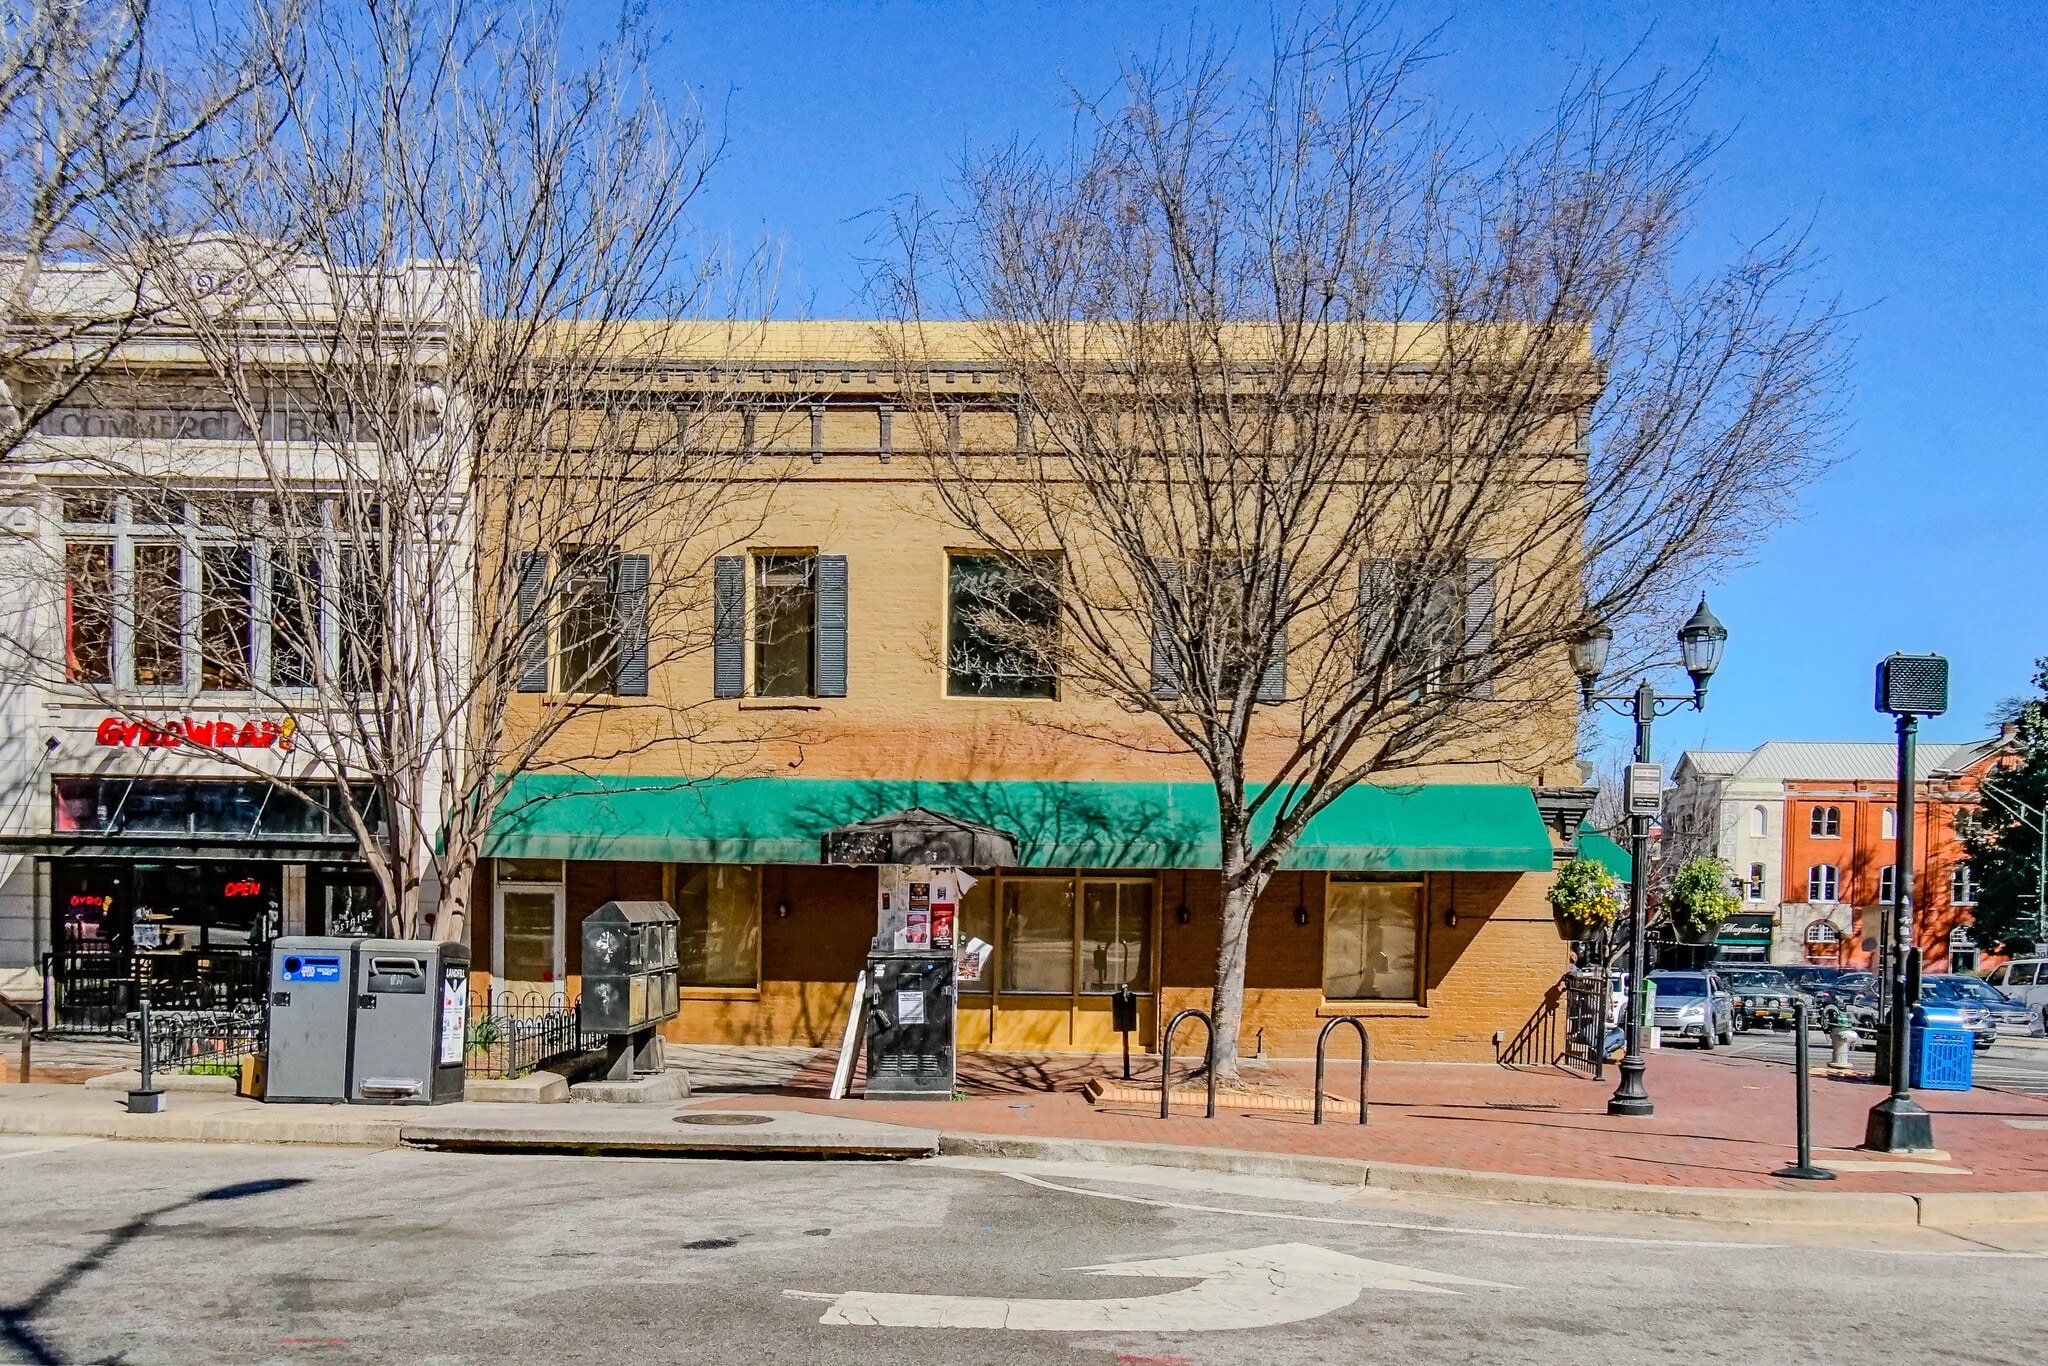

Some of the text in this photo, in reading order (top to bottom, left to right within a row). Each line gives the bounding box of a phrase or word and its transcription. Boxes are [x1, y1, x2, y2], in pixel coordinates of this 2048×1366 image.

[61, 414, 266, 441] COMMERCIA
[225, 882, 260, 896] OPEN
[446, 968, 465, 978] LANDFILL
